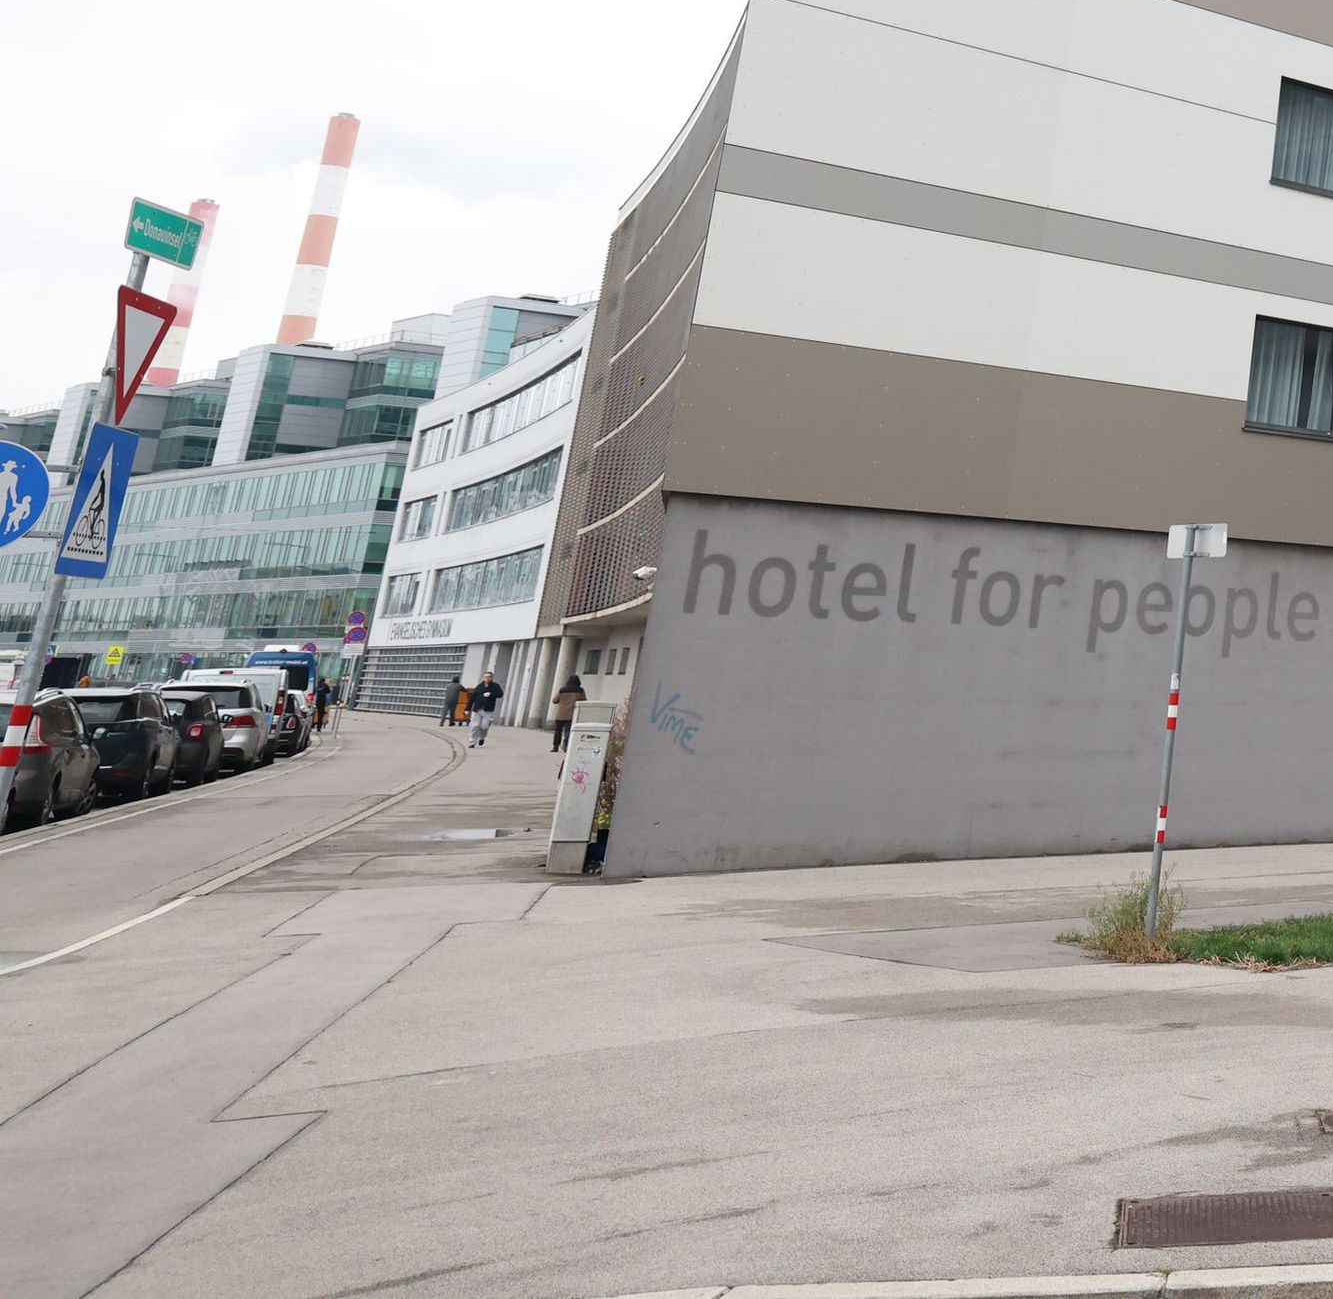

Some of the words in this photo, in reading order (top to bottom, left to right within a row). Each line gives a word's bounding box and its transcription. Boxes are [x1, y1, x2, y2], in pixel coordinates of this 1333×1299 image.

[143, 218, 183, 249] Donauinsel
[682, 528, 918, 623] hotel
[950, 546, 1066, 629] for
[1086, 571, 1320, 658] people
